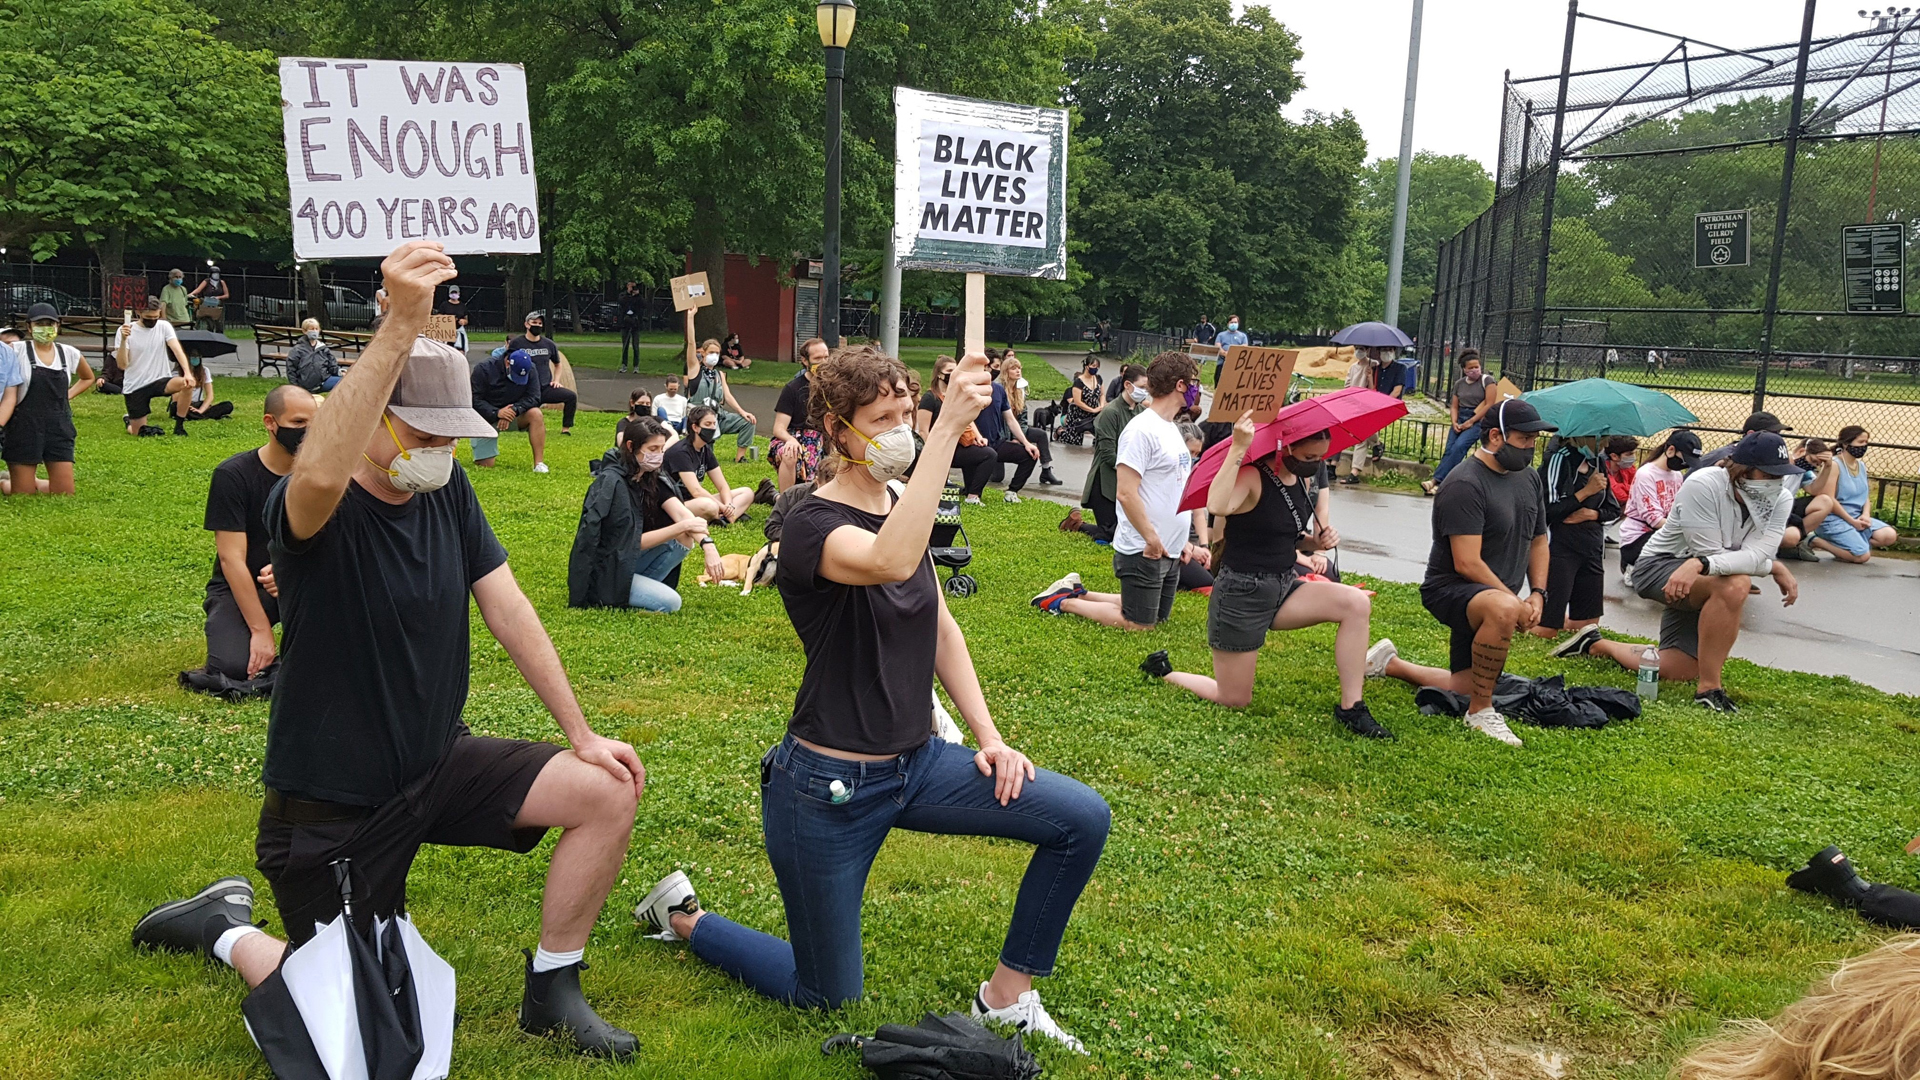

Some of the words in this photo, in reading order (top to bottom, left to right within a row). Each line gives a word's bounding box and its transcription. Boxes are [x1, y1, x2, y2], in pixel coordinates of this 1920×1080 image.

[298, 61, 367, 108] IT
[399, 65, 499, 106] WAS
[300, 115, 529, 182] ENOUGH
[933, 134, 1038, 173] BLACK
[941, 169, 1027, 205] LIVES
[296, 197, 367, 243] 400
[376, 196, 480, 240] YEARS
[486, 202, 535, 241] AGO
[919, 202, 1044, 240] MATTER
[1700, 214, 1743, 223] PATROLMAN
[1705, 222, 1737, 230] STEPHEN
[112, 283, 145, 293] NOW
[112, 292, 146, 301] NOW
[1234, 350, 1285, 373] BLACK
[1236, 371, 1277, 391] LIVES
[1218, 392, 1275, 411] MATTER
